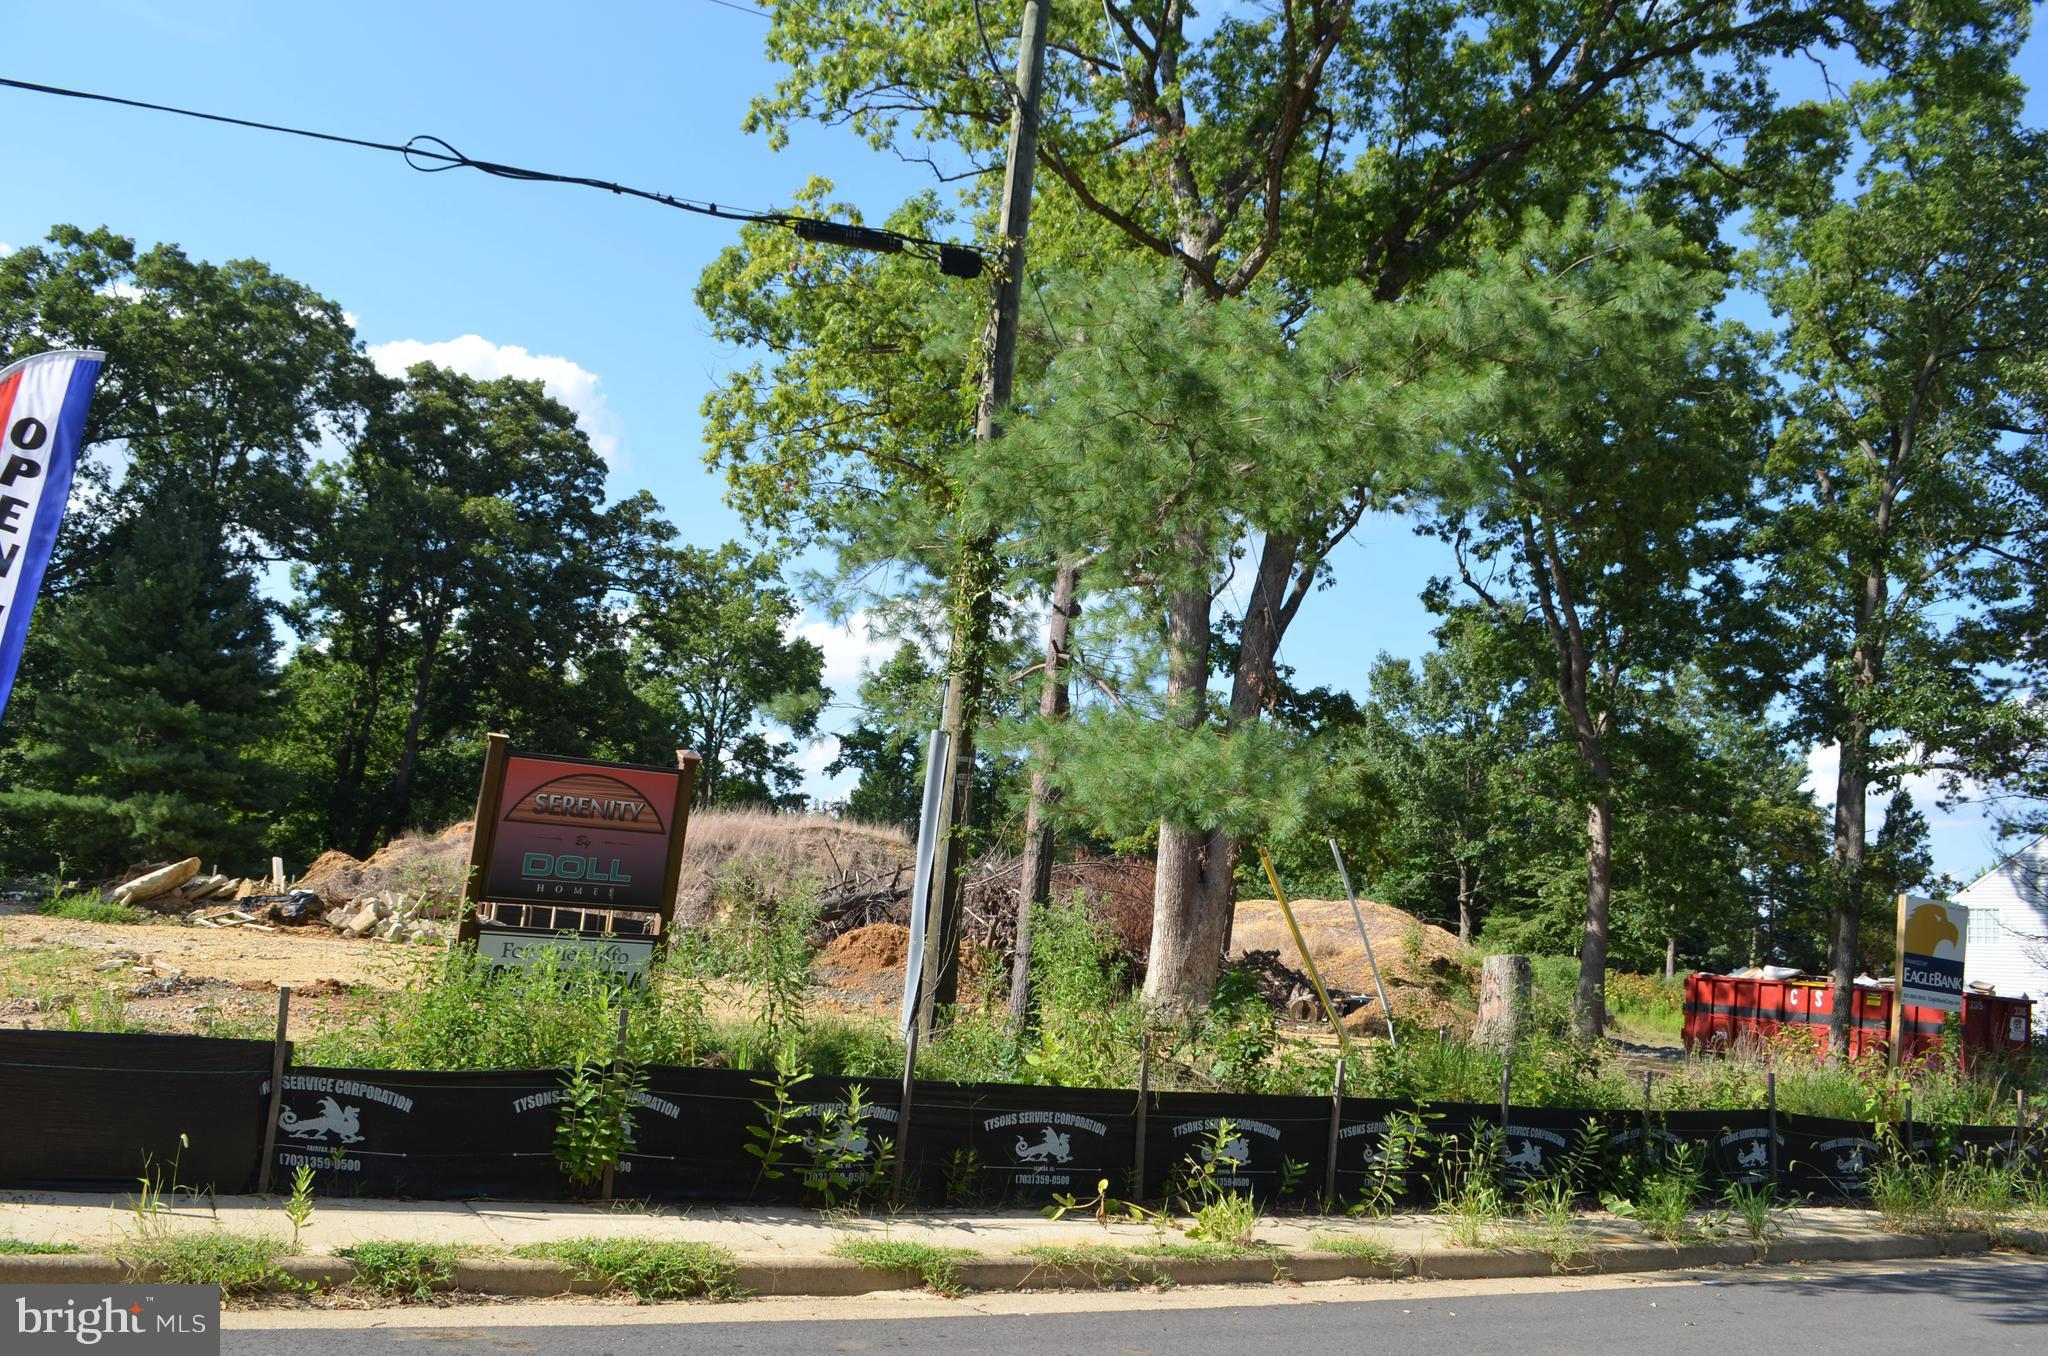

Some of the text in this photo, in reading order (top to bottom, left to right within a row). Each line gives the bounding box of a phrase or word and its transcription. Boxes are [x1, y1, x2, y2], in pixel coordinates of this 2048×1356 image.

[534, 793, 646, 822] SERENITY
[575, 835, 591, 848] By
[521, 852, 632, 882] DOLL
[282, 1075, 334, 1093] SERVICE
[335, 1079, 414, 1113] CORPORATION
[512, 1090, 560, 1114] TYSONS
[984, 1111, 1107, 1137] TYSONS SERVICE CORPORATION
[1172, 1120, 1204, 1139] TYSONS
[1236, 1118, 1281, 1141] CORPORATION
[1339, 1123, 1366, 1140] TYSONS
